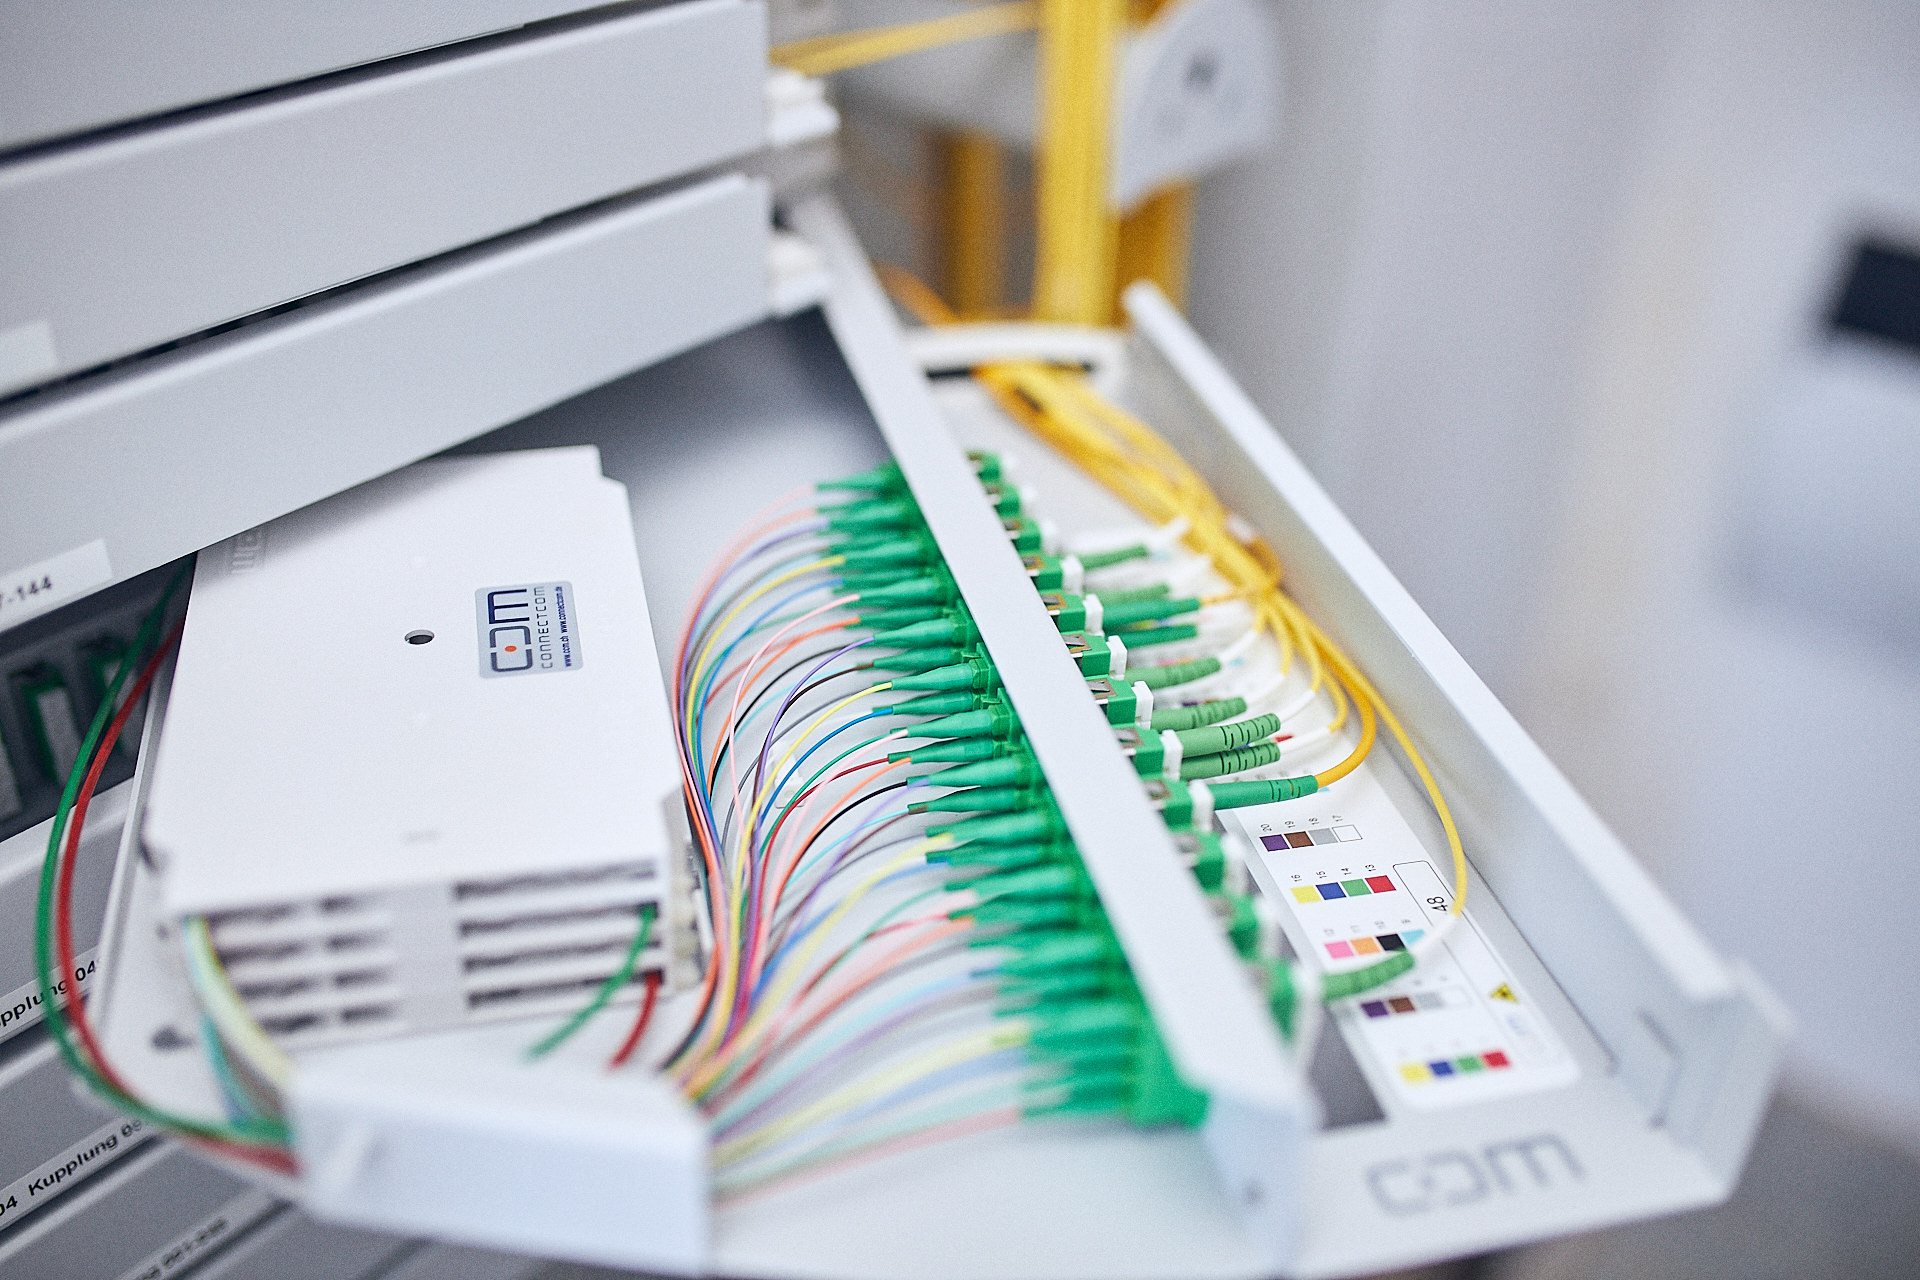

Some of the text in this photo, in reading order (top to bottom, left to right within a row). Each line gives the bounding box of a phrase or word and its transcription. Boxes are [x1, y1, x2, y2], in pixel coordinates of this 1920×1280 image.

[0, 575, 52, 609] -144
[1260, 823, 1272, 832] 20
[1284, 820, 1296, 829] 19
[1291, 864, 1377, 883] 16 15 14 13
[0, 960, 97, 1028] pplung 04
[28, 1134, 118, 1197] Kupplung
